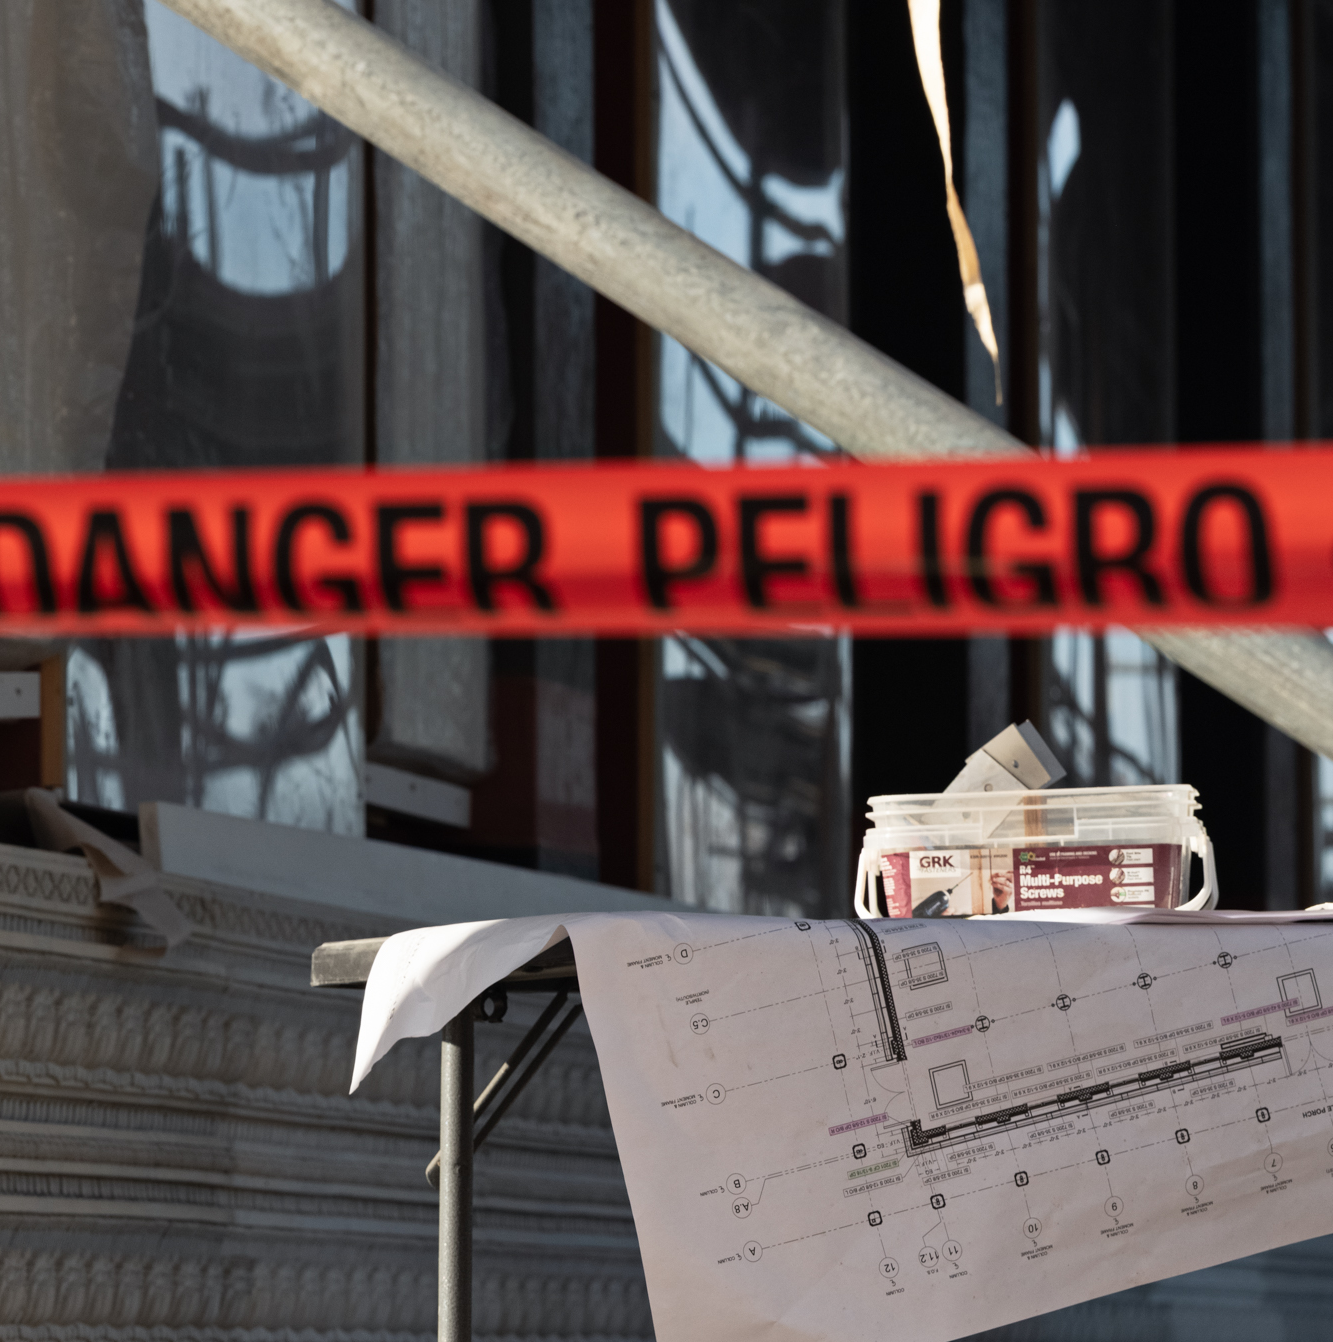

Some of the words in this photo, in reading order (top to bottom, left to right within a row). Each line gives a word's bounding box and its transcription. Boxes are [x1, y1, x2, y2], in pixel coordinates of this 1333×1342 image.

[633, 479, 1279, 614] PELIGRO
[919, 855, 954, 868] GRK
[1020, 873, 1103, 887] Multi-Purpose
[1020, 887, 1064, 899] Screws
[680, 949, 688, 958] D
[692, 1018, 709, 1030] C.5
[712, 1089, 721, 1099] C
[1302, 1107, 1326, 1118] PORCH
[1270, 1159, 1277, 1167] 7
[733, 1179, 741, 1188] B
[1192, 1181, 1198, 1190] 8
[734, 1202, 751, 1213] A.8
[1111, 1202, 1118, 1211] 9
[1027, 1223, 1039, 1233] 10
[749, 1247, 757, 1256] A
[947, 1246, 958, 1255] 11
[919, 1251, 939, 1263] 11.2
[884, 1263, 895, 1273] 12
